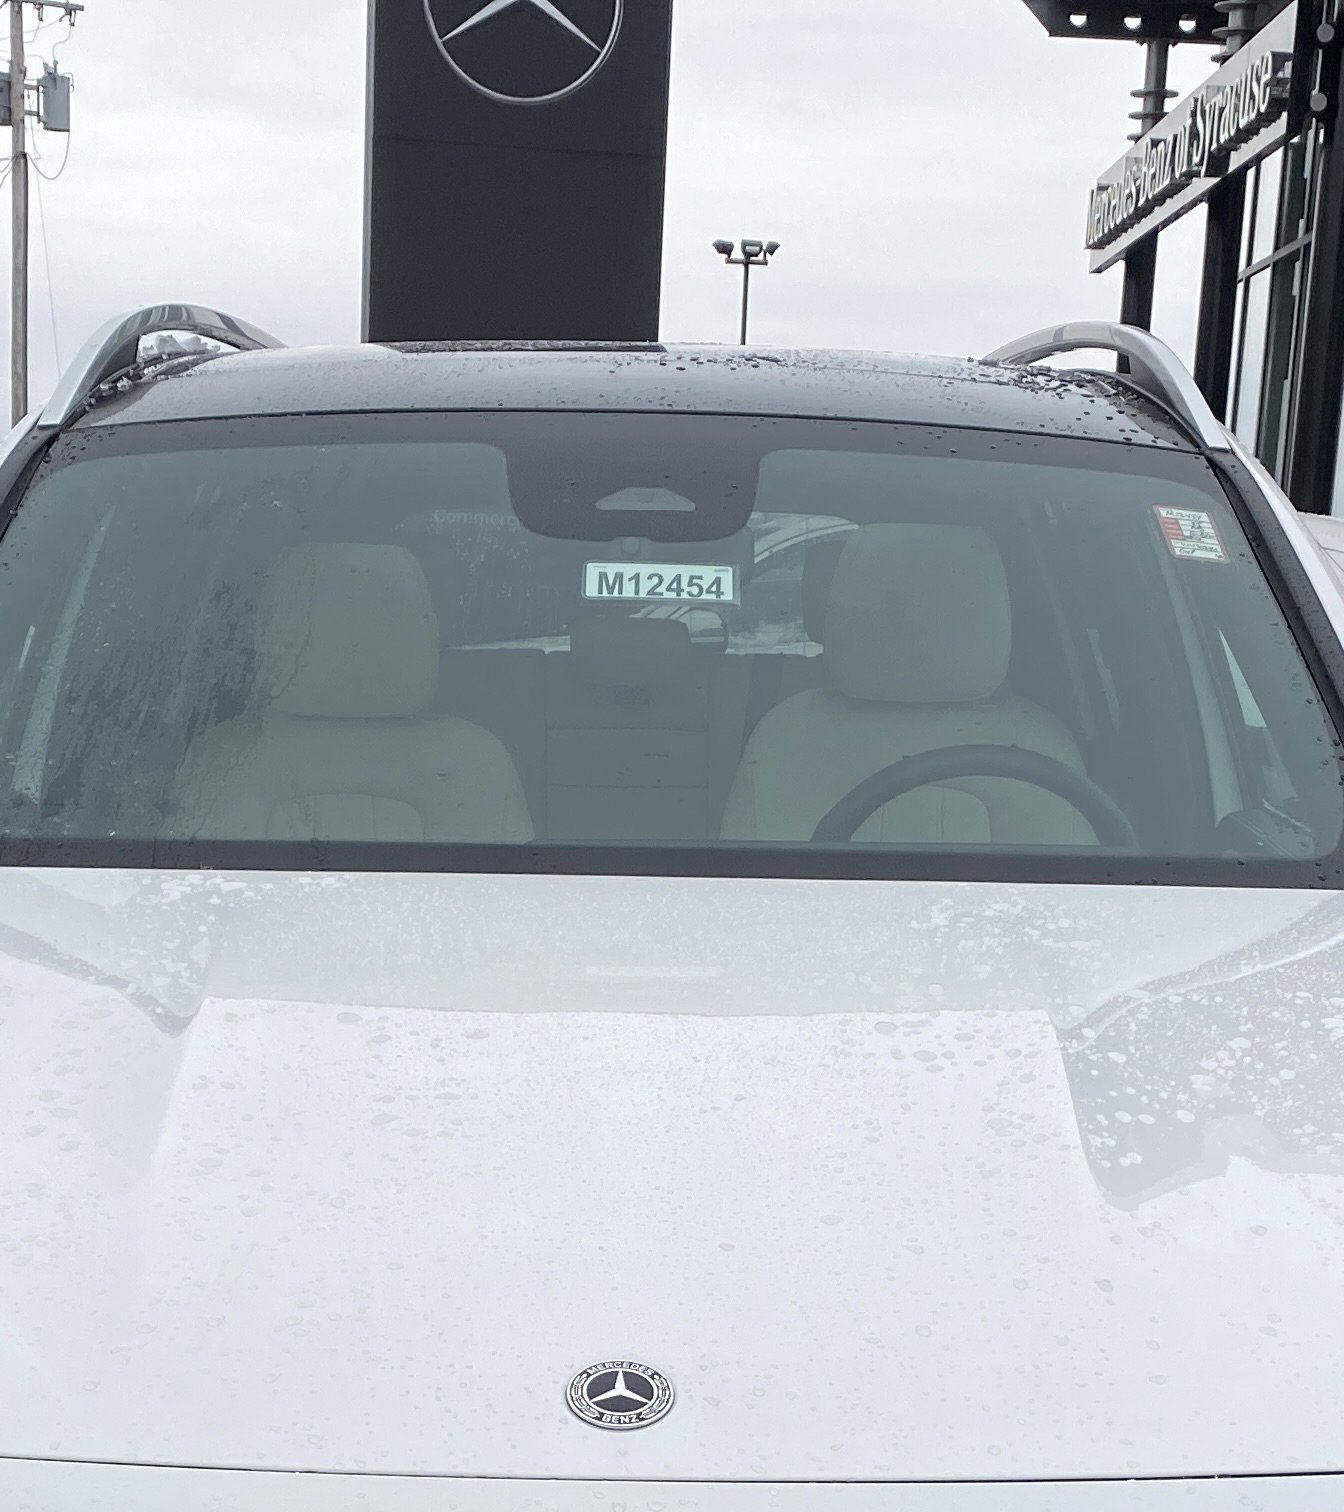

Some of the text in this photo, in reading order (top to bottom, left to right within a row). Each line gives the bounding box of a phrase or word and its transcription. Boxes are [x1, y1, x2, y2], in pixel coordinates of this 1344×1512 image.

[1192, 50, 1274, 179] Syracuse
[597, 571, 725, 599] M12454
[587, 1361, 654, 1375] MERCEDES
[601, 1413, 640, 1425] BENZ
